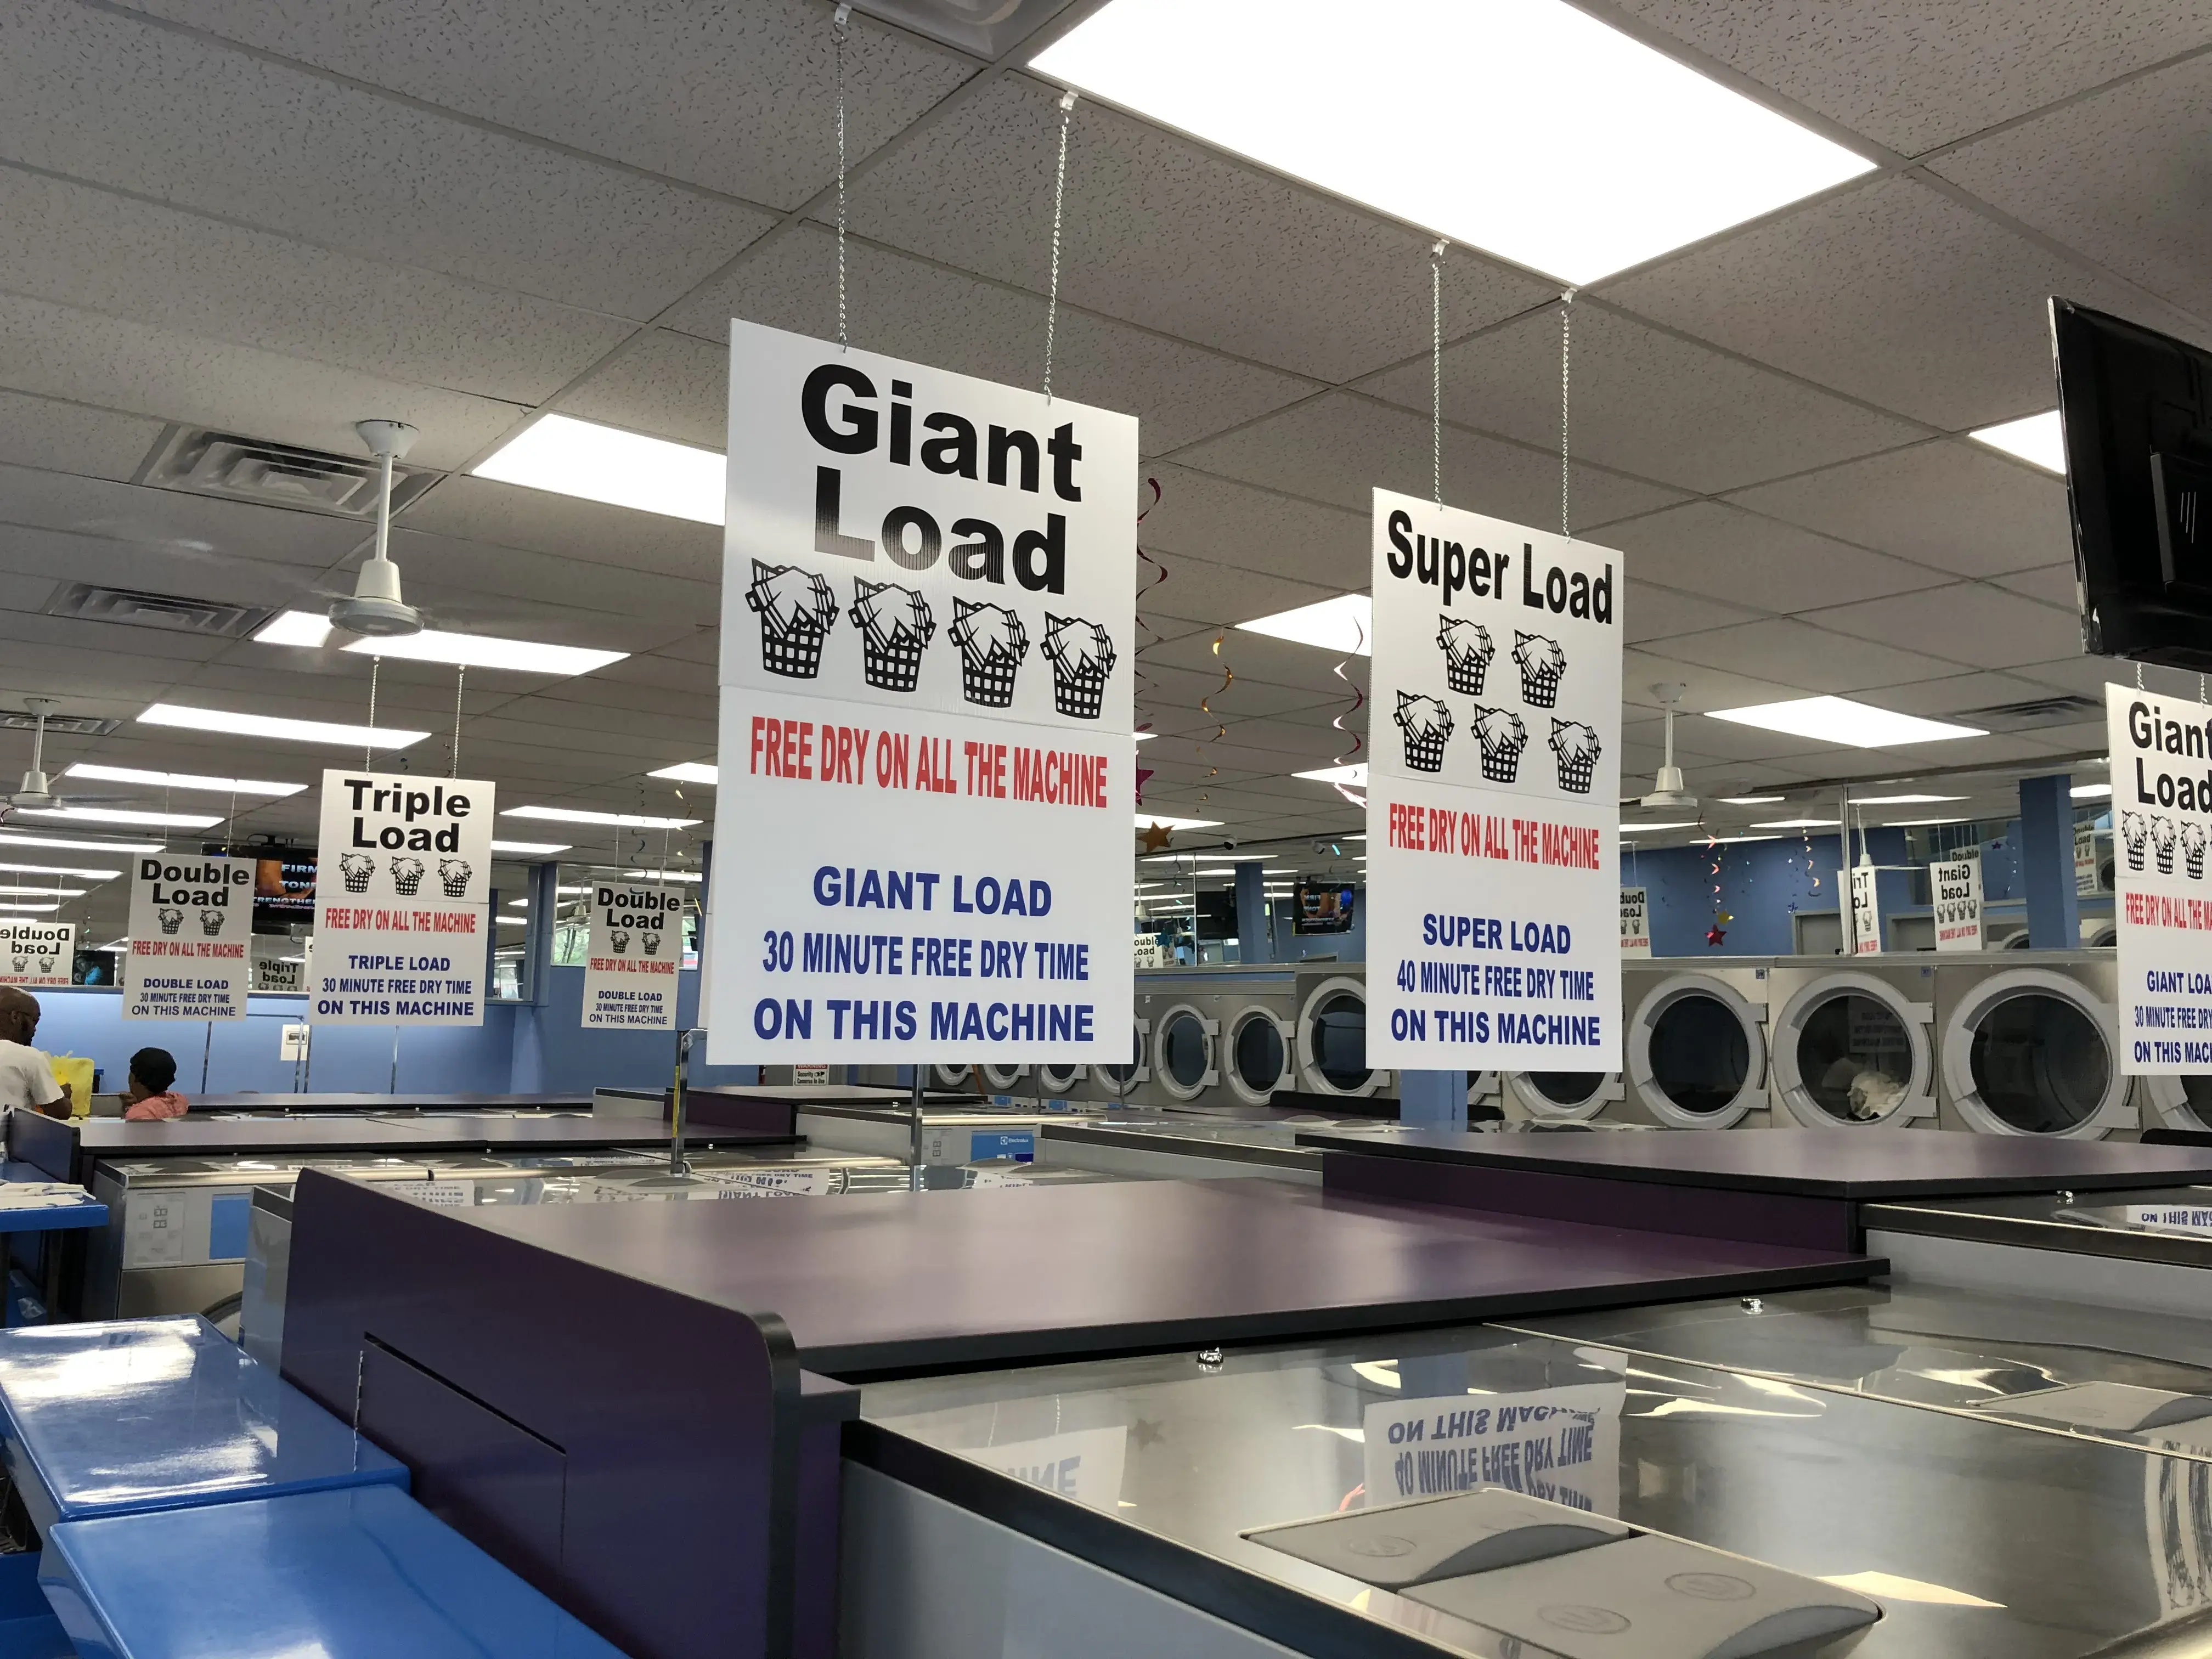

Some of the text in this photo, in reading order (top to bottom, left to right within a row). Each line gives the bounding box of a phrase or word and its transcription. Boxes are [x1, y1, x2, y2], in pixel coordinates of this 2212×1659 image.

[802, 364, 1082, 503] Giant
[814, 465, 1066, 595] Load
[1387, 510, 1612, 624] Super Load
[751, 716, 1107, 808] FREE DRY ON ALL THE MACHINE
[2136, 757, 2212, 812] Load
[344, 778, 471, 822] Triple
[353, 817, 460, 853] Load
[1390, 803, 1599, 870] FREE DRY ON ALL THE MACHINE
[141, 859, 249, 885] Double
[281, 864, 318, 873] FIRM
[153, 883, 229, 906] Load
[253, 896, 316, 905] TRENGTHE
[598, 888, 680, 911] Double
[814, 866, 1051, 916] GIANT LOAD
[326, 909, 475, 933] FREE DRY ON ALL THE MACHINE
[607, 909, 664, 929] Load
[2126, 893, 2143, 924] FREE
[2146, 895, 2159, 926] DRY
[2162, 896, 2171, 927] ON
[2174, 898, 2187, 928] ALL
[2188, 900, 2202, 929] THE
[1423, 914, 1570, 954] SUPER LOAD
[133, 941, 244, 958] FREE DRY ON ALL THE MACHINE
[763, 930, 1088, 980] 30 MINUTE FREE DRY TIME
[1134, 946, 1155, 956] oad
[348, 955, 450, 970] TRIPLE LOAD
[590, 958, 674, 974] FREE DRY ON ALL THE MACHINE
[144, 979, 228, 989] DOUBLE LOAD
[323, 978, 471, 994] 30 MINUTE FREE DRY TIME
[1397, 960, 1594, 1000] 40 MINUTE FREE DRY TIME
[2147, 970, 2212, 995] GIANT LOA
[140, 992, 229, 1003] 30 MINUTE FREE DRY TIME
[318, 1000, 473, 1015] ON THIS MACHINE
[599, 991, 662, 1001] DOUBLE LOAD
[132, 1006, 235, 1016] ON THIS MACHINE
[590, 1014, 667, 1024] ON THIS MACHINE
[596, 1003, 602, 1011] 30
[603, 1003, 623, 1012] MINUTE
[624, 1004, 637, 1012] FREE
[651, 1005, 663, 1013] TIME
[754, 998, 1093, 1041] ON THIS MACHINE
[2135, 1006, 2143, 1027] 30
[2146, 1006, 2175, 1028] MINUTE
[2177, 1008, 2196, 1028] FREE
[1391, 1009, 1600, 1045] ON THIS MACHINE
[2135, 1041, 2151, 1062] ON
[2154, 1042, 2181, 1063] THIS
